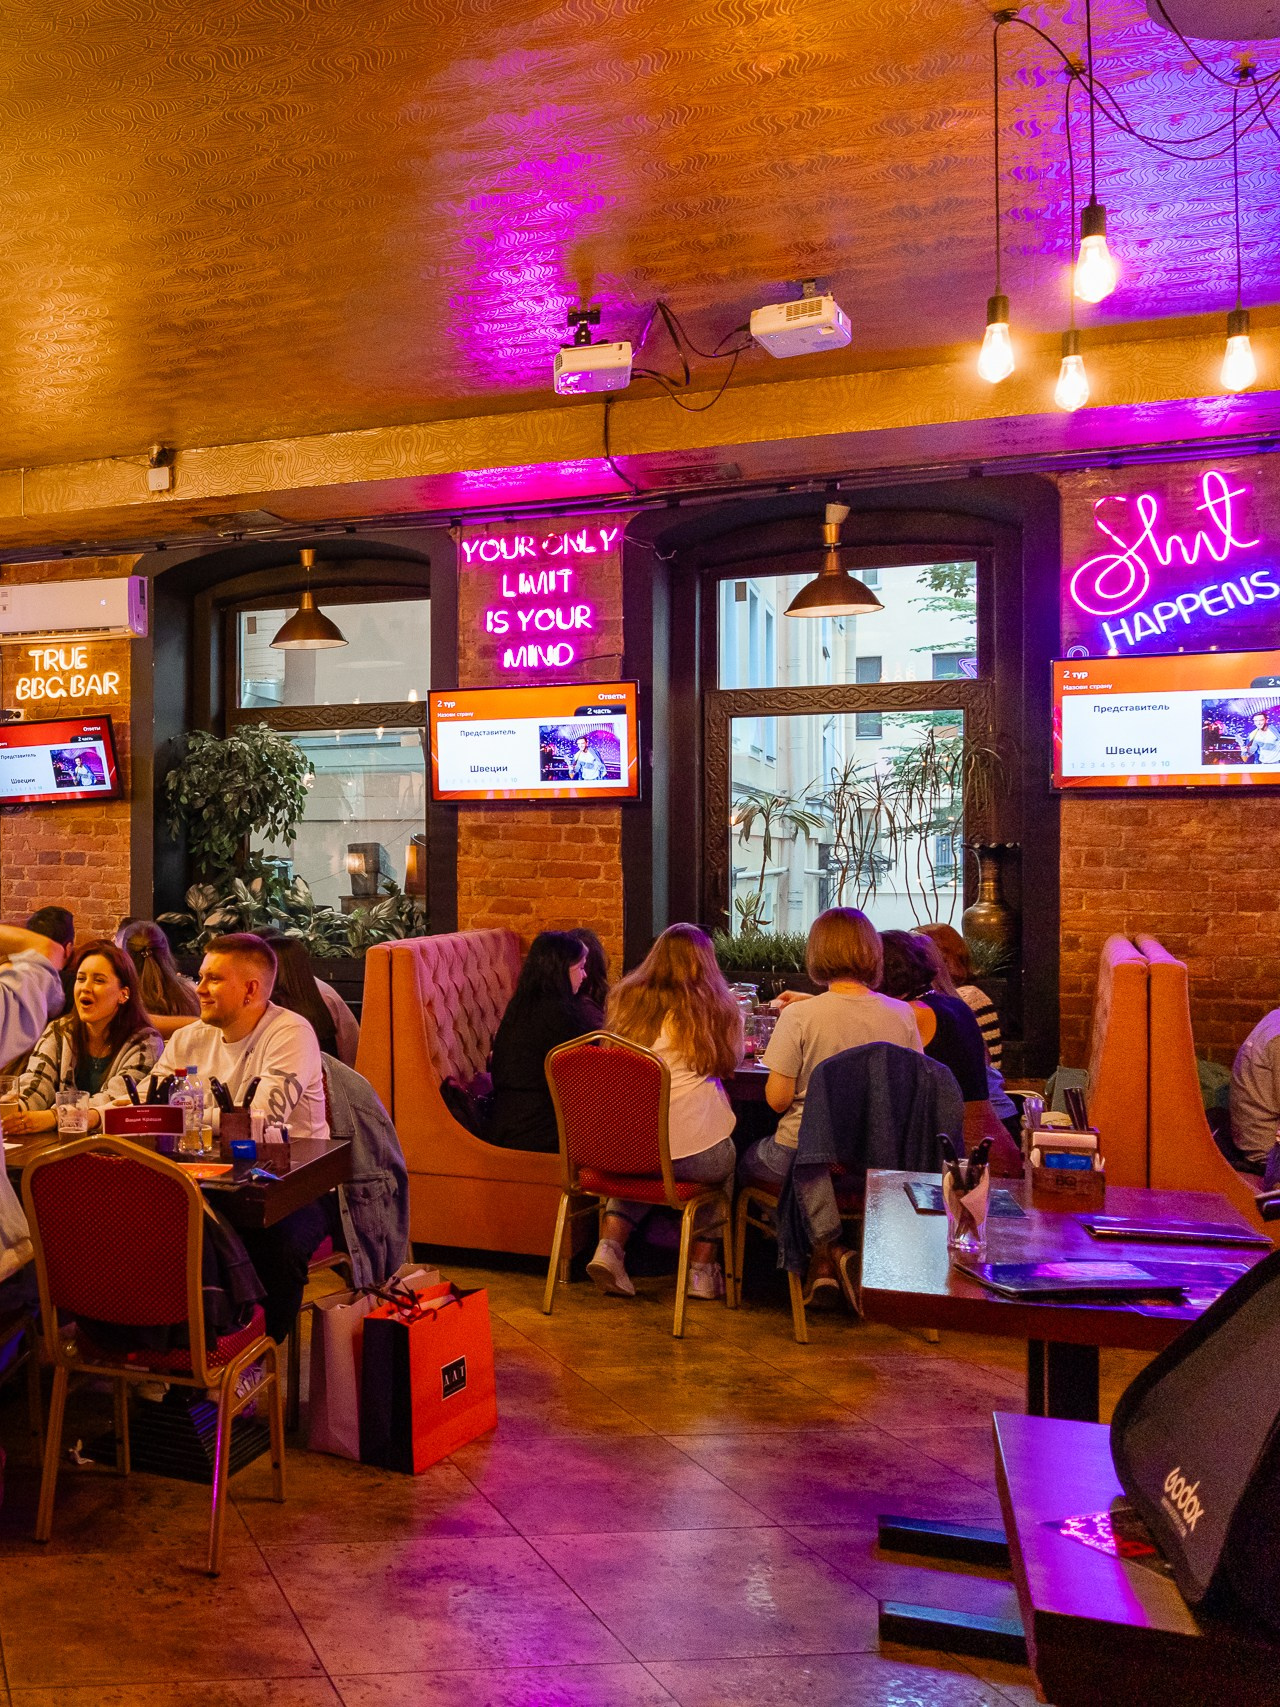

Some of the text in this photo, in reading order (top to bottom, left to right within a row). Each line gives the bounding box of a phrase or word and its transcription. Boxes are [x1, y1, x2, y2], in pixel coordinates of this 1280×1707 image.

[461, 528, 618, 563] YOUR ONLY
[502, 568, 573, 598] LIMIT
[486, 605, 592, 634] IS YOUR
[1102, 570, 1280, 650] HAPPENS
[28, 646, 88, 672] TRUE
[503, 643, 574, 668] MIND
[70, 672, 120, 697] BAR
[1063, 670, 1088, 679] 2 тур
[1268, 678, 1275, 686] 2
[1093, 704, 1170, 714] Представитель
[460, 729, 516, 738] Представитель
[1105, 746, 1158, 756] Швеции
[470, 765, 508, 774] Швеции
[1164, 1466, 1205, 1534] Godox
